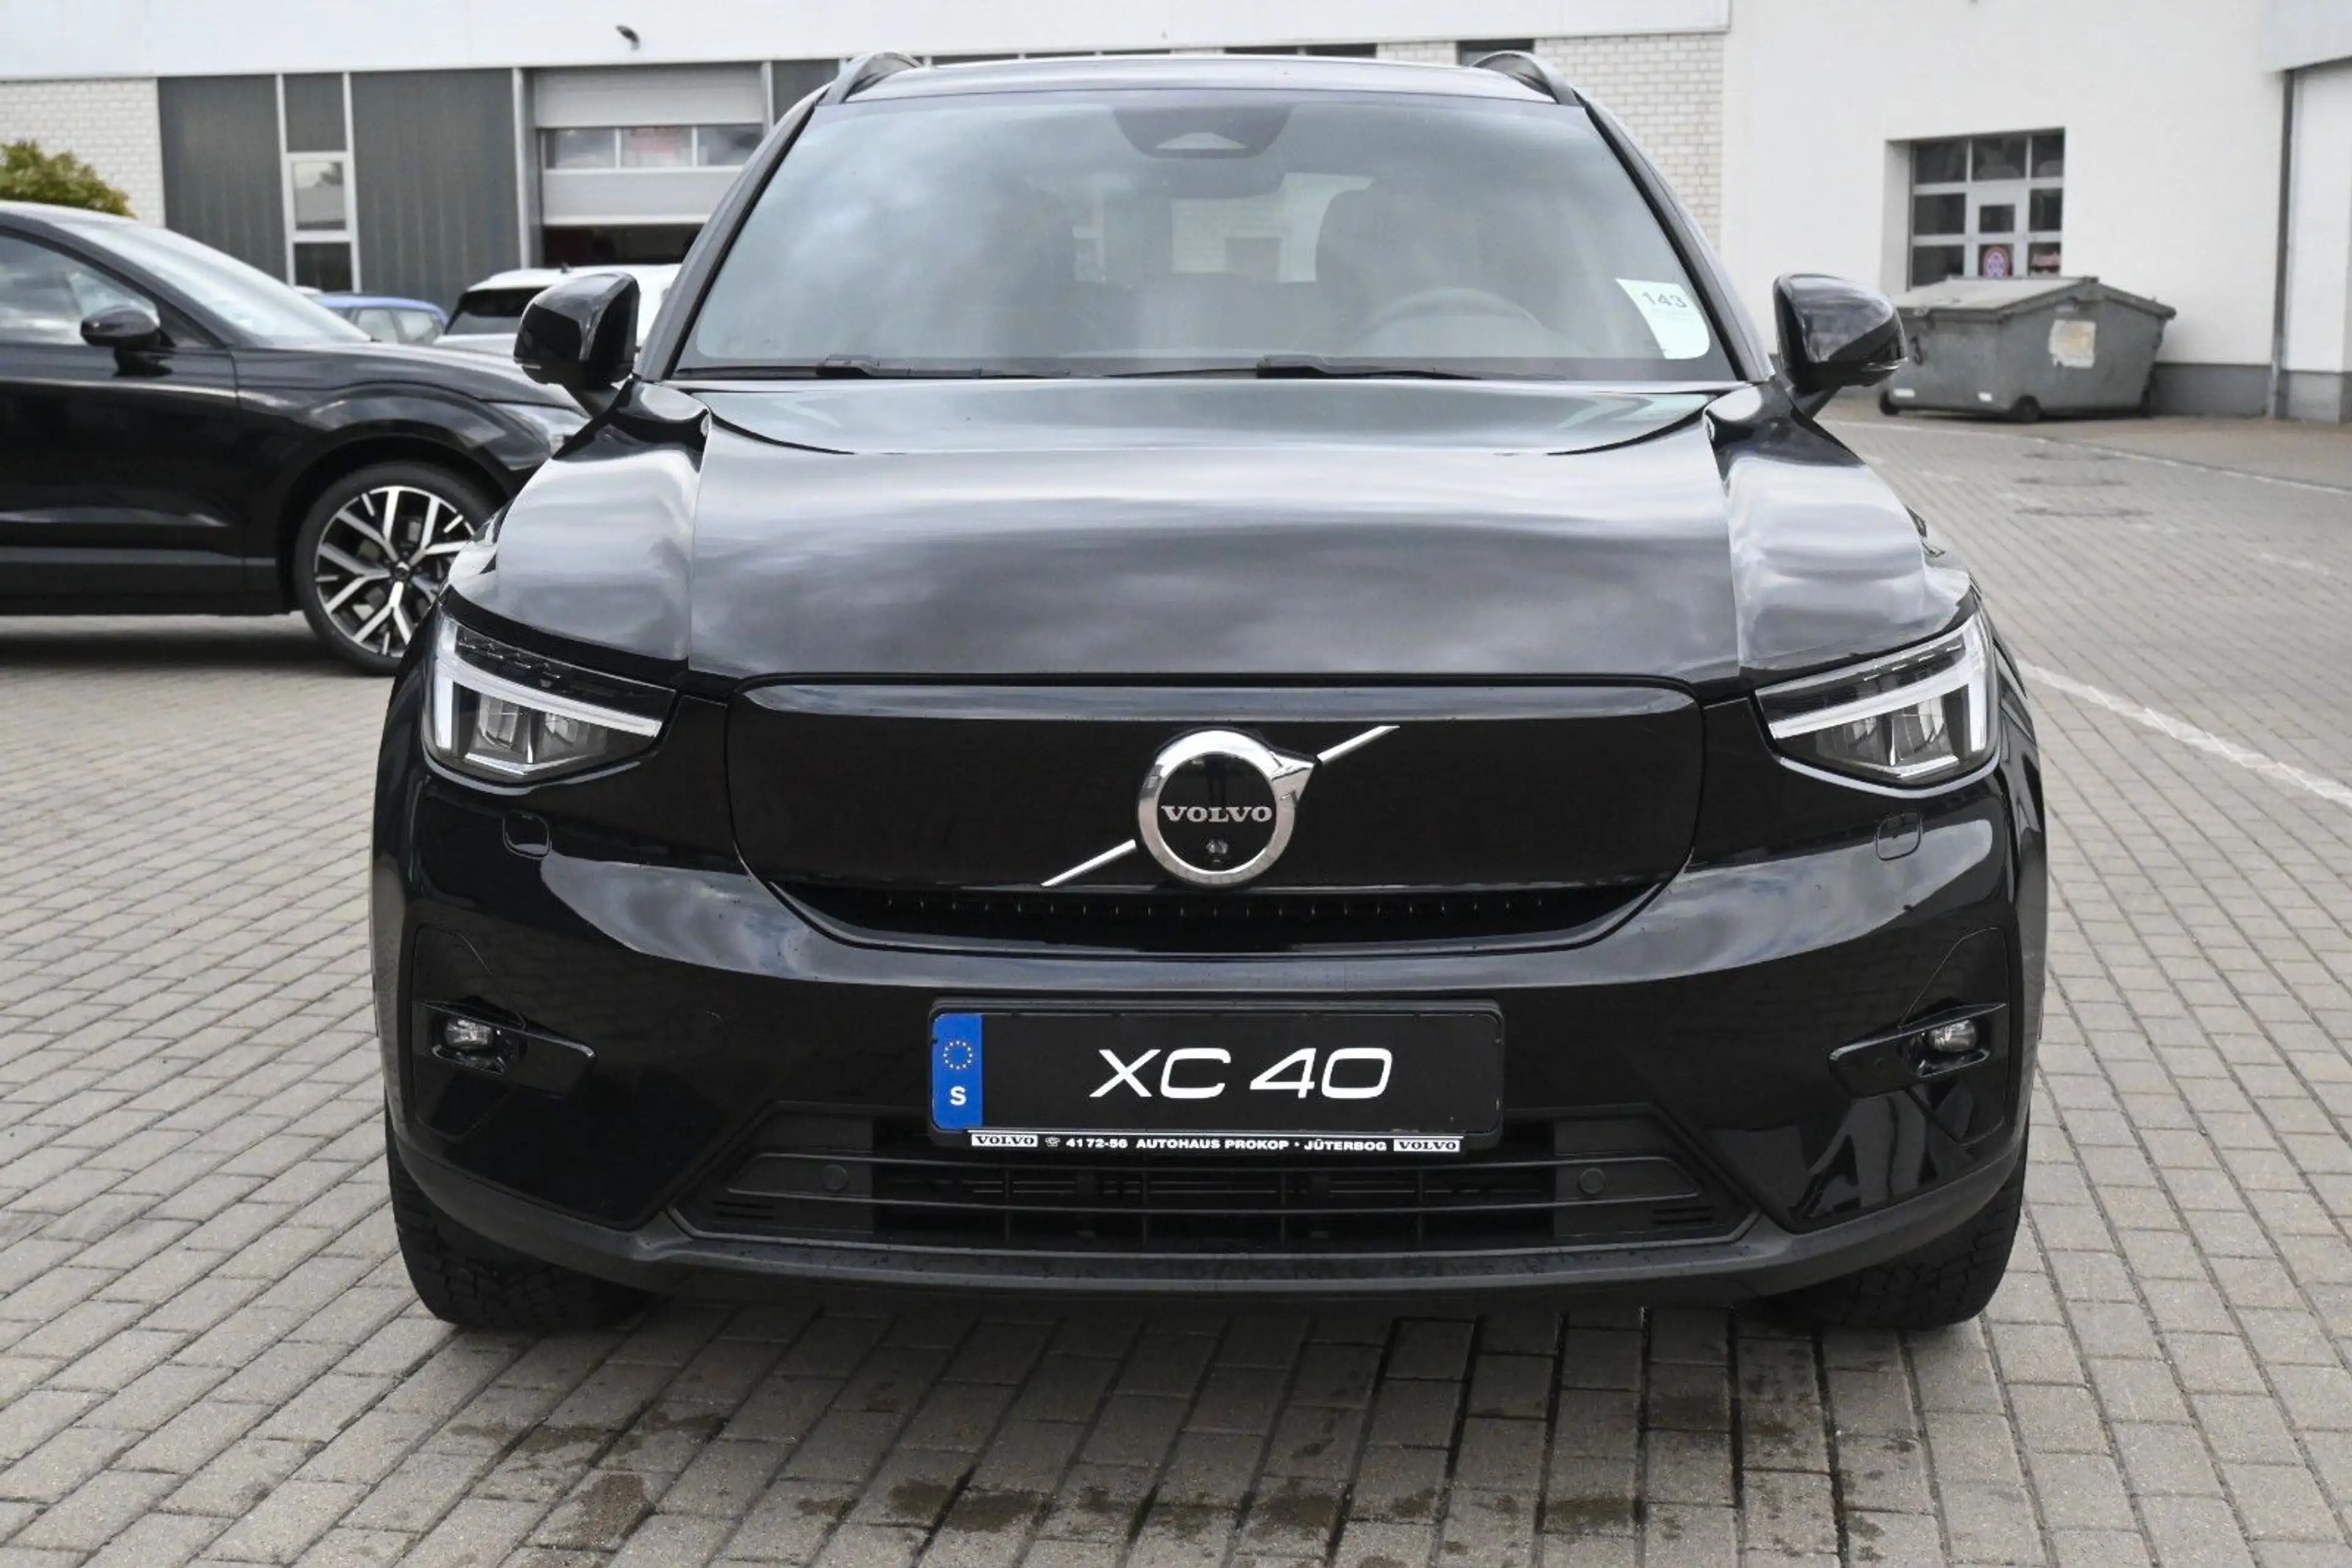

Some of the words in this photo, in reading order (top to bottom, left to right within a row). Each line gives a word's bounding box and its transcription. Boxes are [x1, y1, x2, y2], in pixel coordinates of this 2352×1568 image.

[1642, 292, 1687, 308] 143
[1161, 805, 1273, 823] VOLVO
[1089, 1047, 1232, 1099] XC
[1249, 1047, 1393, 1099] 40
[950, 1086, 967, 1106] S
[976, 1136, 1035, 1145] VOLVO
[1136, 1138, 1221, 1150] AUTOHAUS
[1224, 1139, 1290, 1150] PROKOP
[1303, 1138, 1387, 1152] JÜTERBOG
[1398, 1140, 1457, 1151] VOLVO
